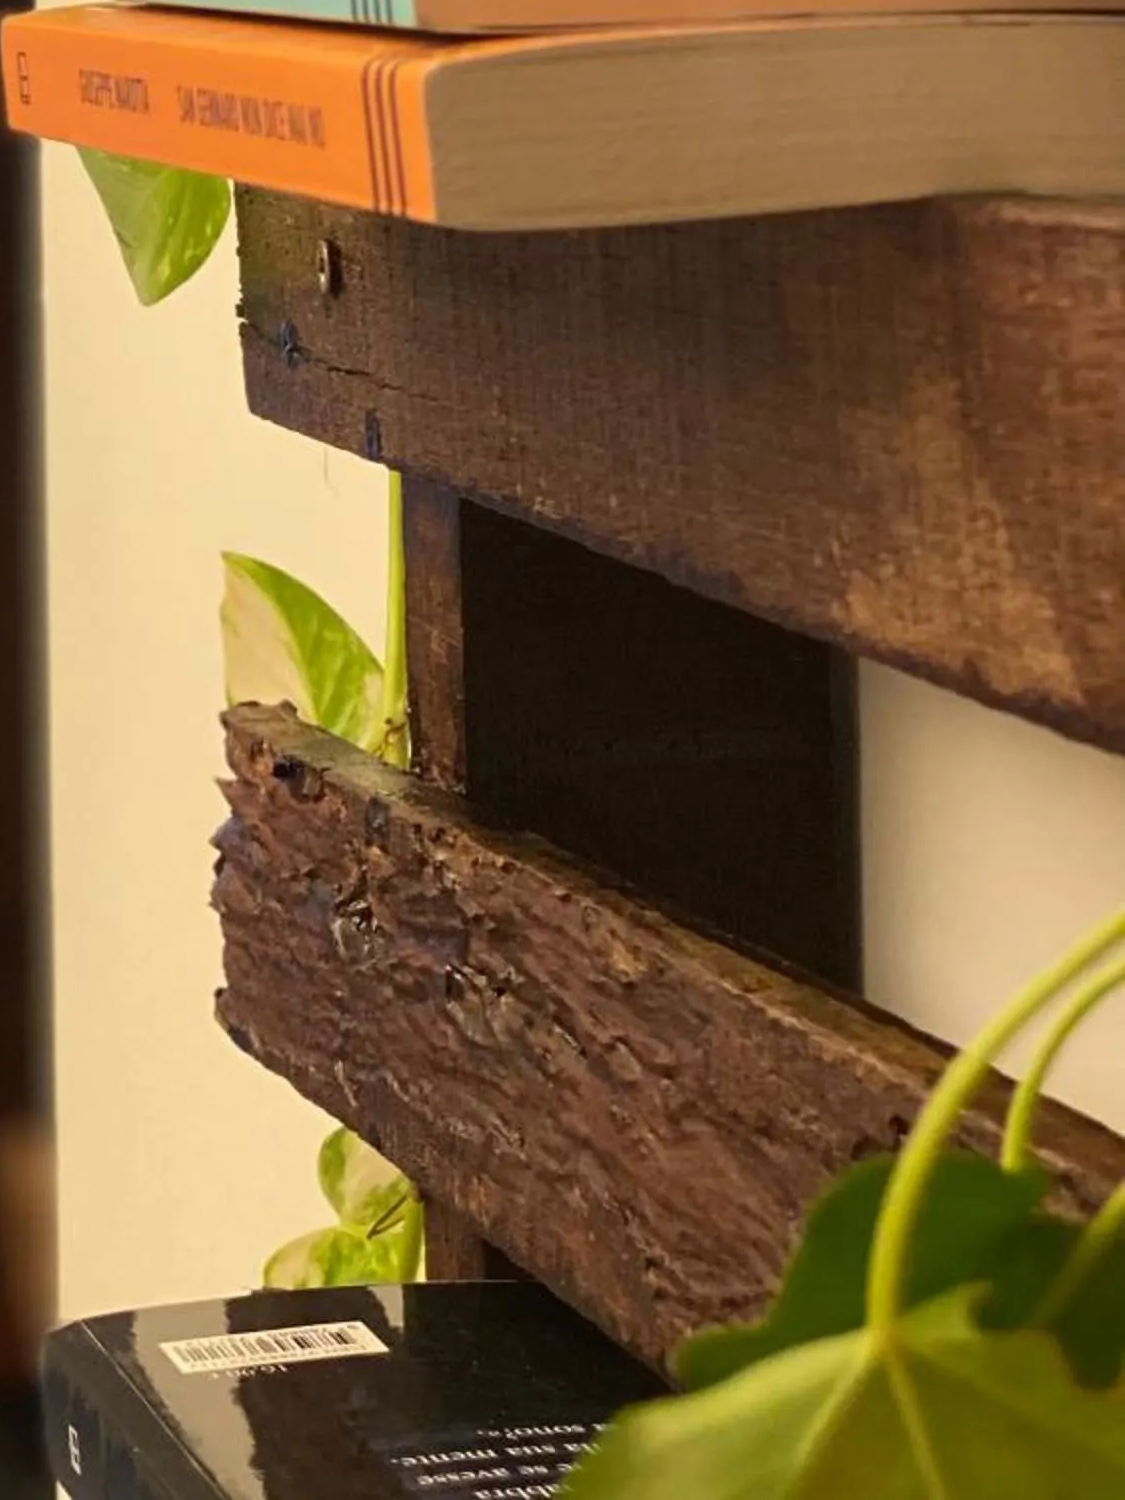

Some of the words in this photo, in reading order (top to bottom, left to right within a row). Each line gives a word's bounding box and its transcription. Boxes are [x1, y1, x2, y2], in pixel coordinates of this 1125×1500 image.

[390, 1448, 500, 1467] mente.
[504, 1444, 557, 1457] sua
[416, 1466, 511, 1486] avesse
[473, 1482, 572, 1500] abbra
